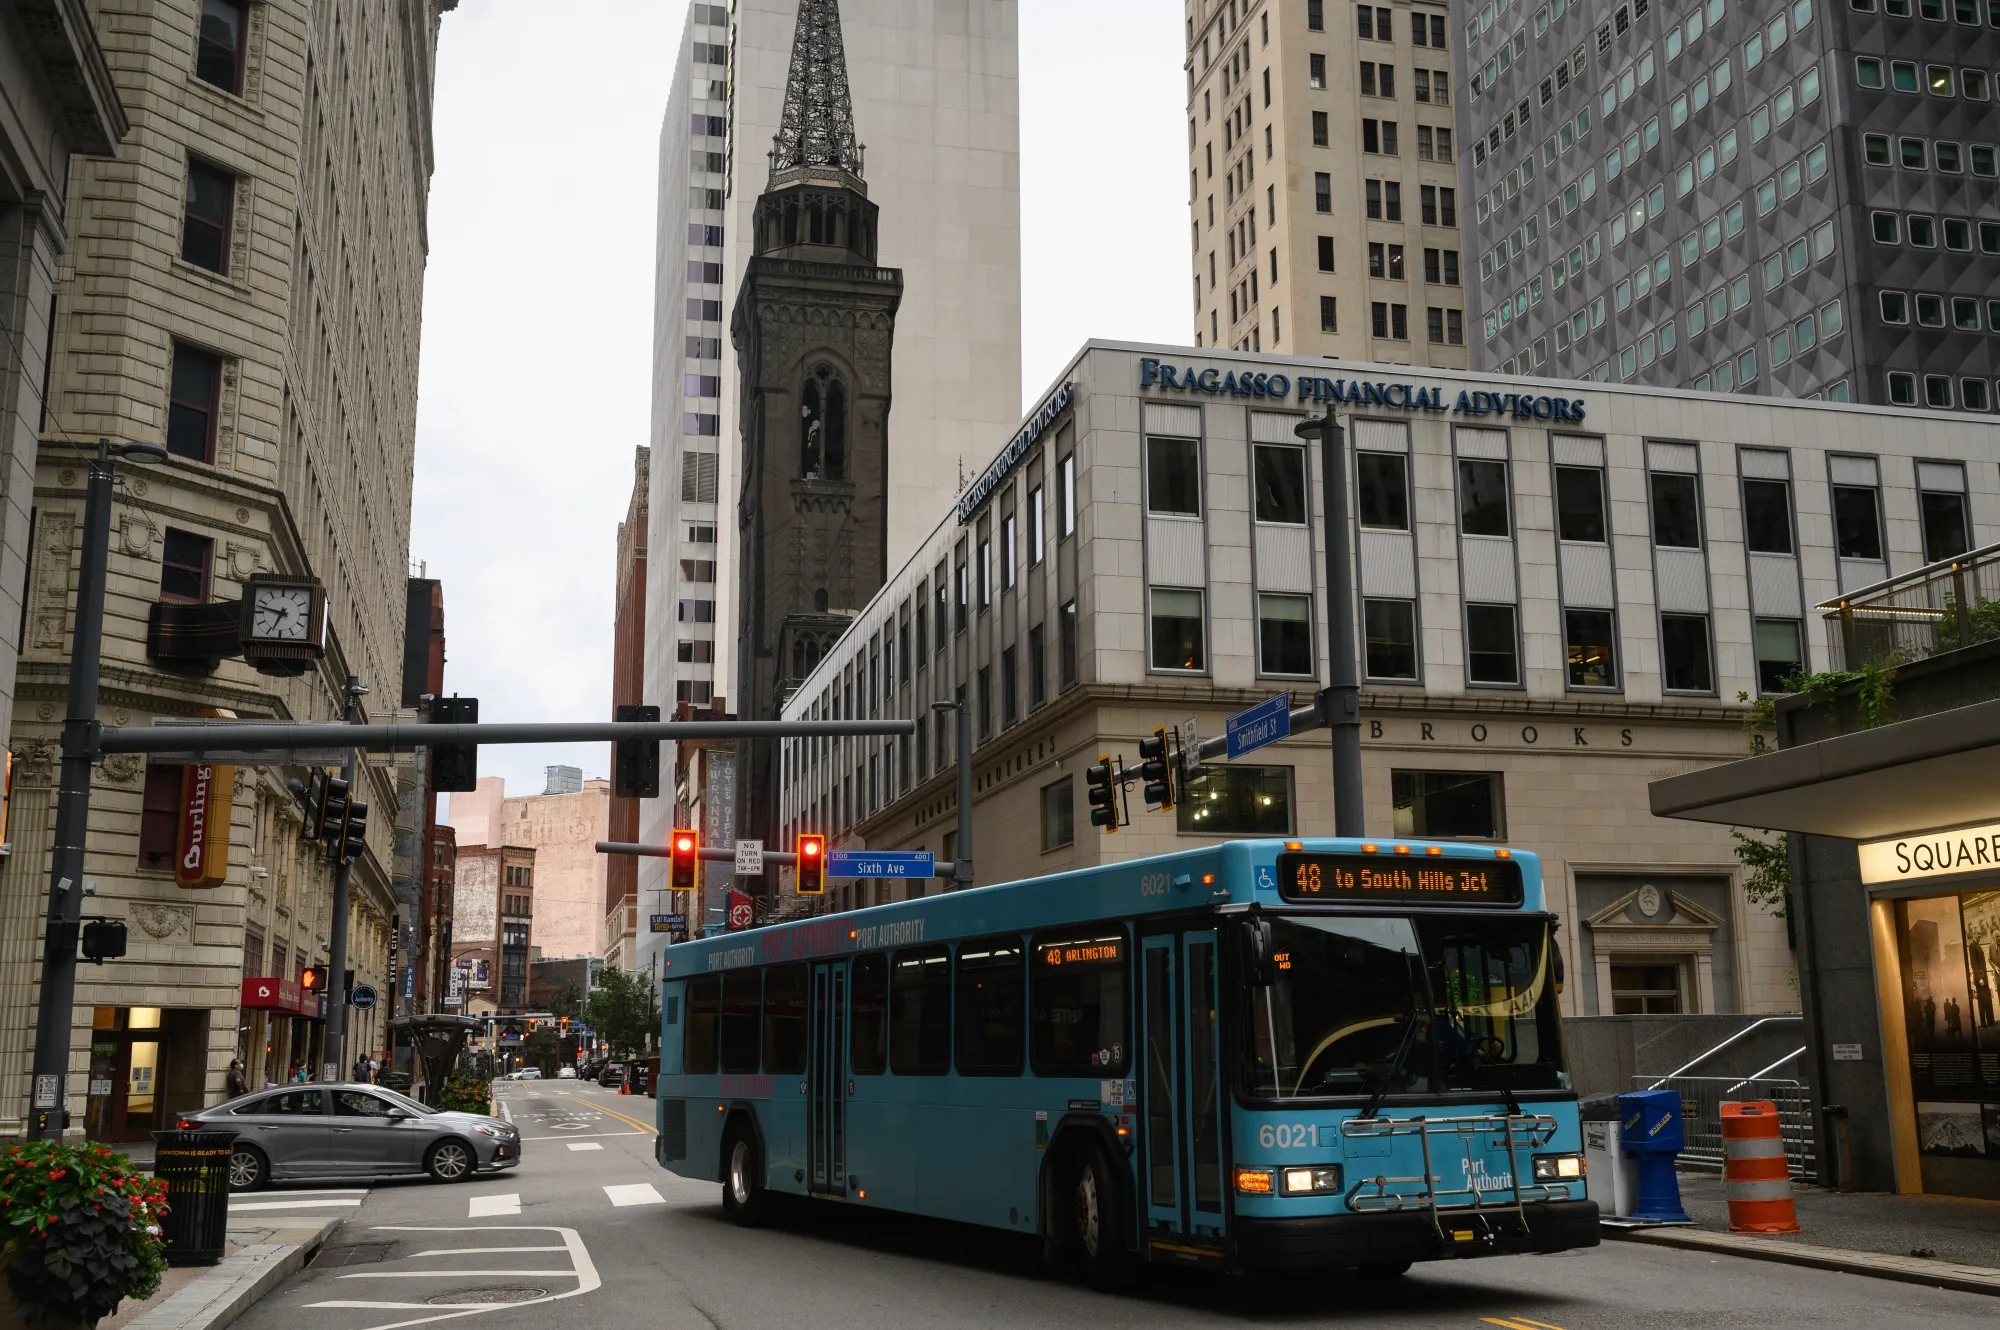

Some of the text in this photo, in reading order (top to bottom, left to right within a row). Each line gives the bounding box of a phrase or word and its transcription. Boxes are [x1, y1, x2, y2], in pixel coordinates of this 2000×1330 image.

[1140, 357, 1586, 421] FRAGASSO FINANCIAL ADVISORS
[1027, 381, 1074, 445] ADVISORS
[1237, 717, 1277, 749] Smithfield St
[1371, 721, 1632, 746] BROOKS
[710, 785, 720, 848] RANDAL
[1895, 834, 2000, 874] SQUARE
[858, 862, 905, 874] Sixth Ave
[1297, 863, 1488, 892] 48 to South Hills Jct
[1141, 873, 1171, 896] 6021
[857, 918, 925, 950] PORT AUTHORITY
[389, 954, 397, 983] STEEL
[708, 947, 755, 971] PORT AUTHORITY
[1047, 946, 1117, 965] 48 ARLINGTON
[1274, 953, 1290, 962] OUT
[1260, 1123, 1318, 1148] 6021
[1466, 1172, 1514, 1191] Authorit
